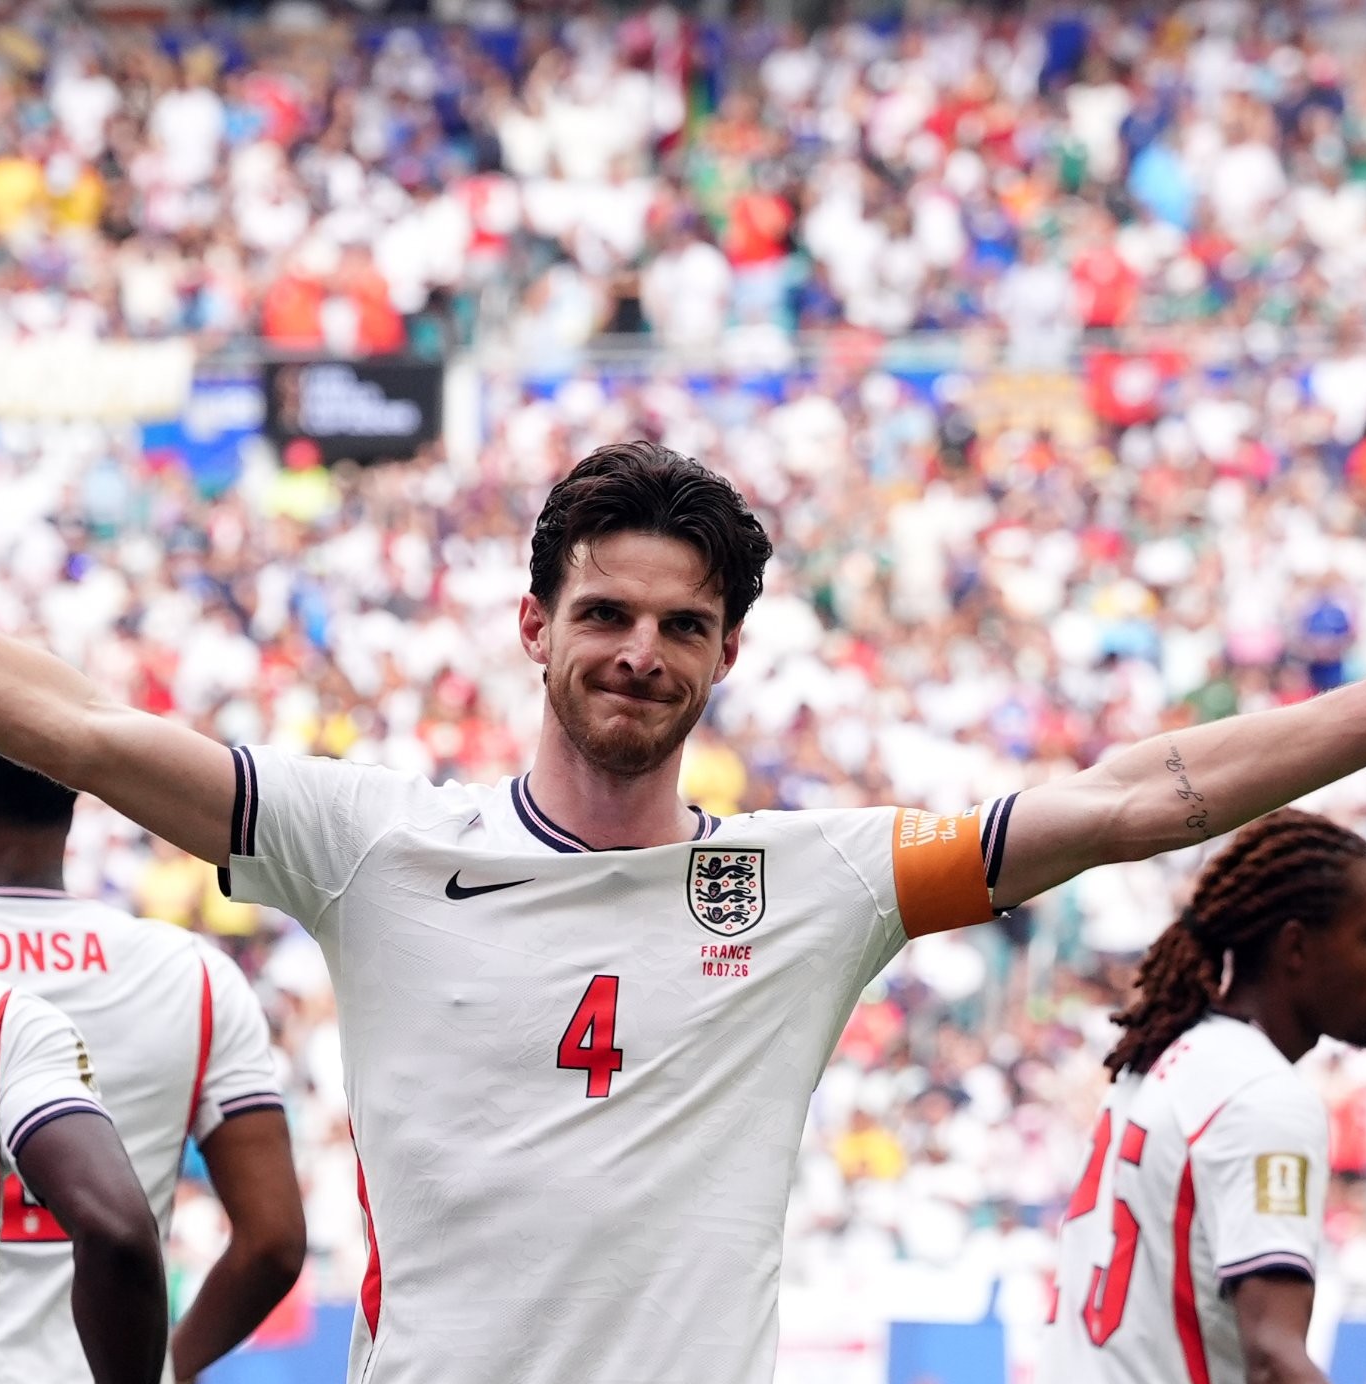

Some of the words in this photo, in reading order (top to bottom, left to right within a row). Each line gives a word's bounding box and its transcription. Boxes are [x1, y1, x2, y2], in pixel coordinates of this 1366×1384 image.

[701, 944, 752, 960] FRANCE
[702, 961, 749, 977] 18.07.26
[556, 974, 623, 1098] 4
